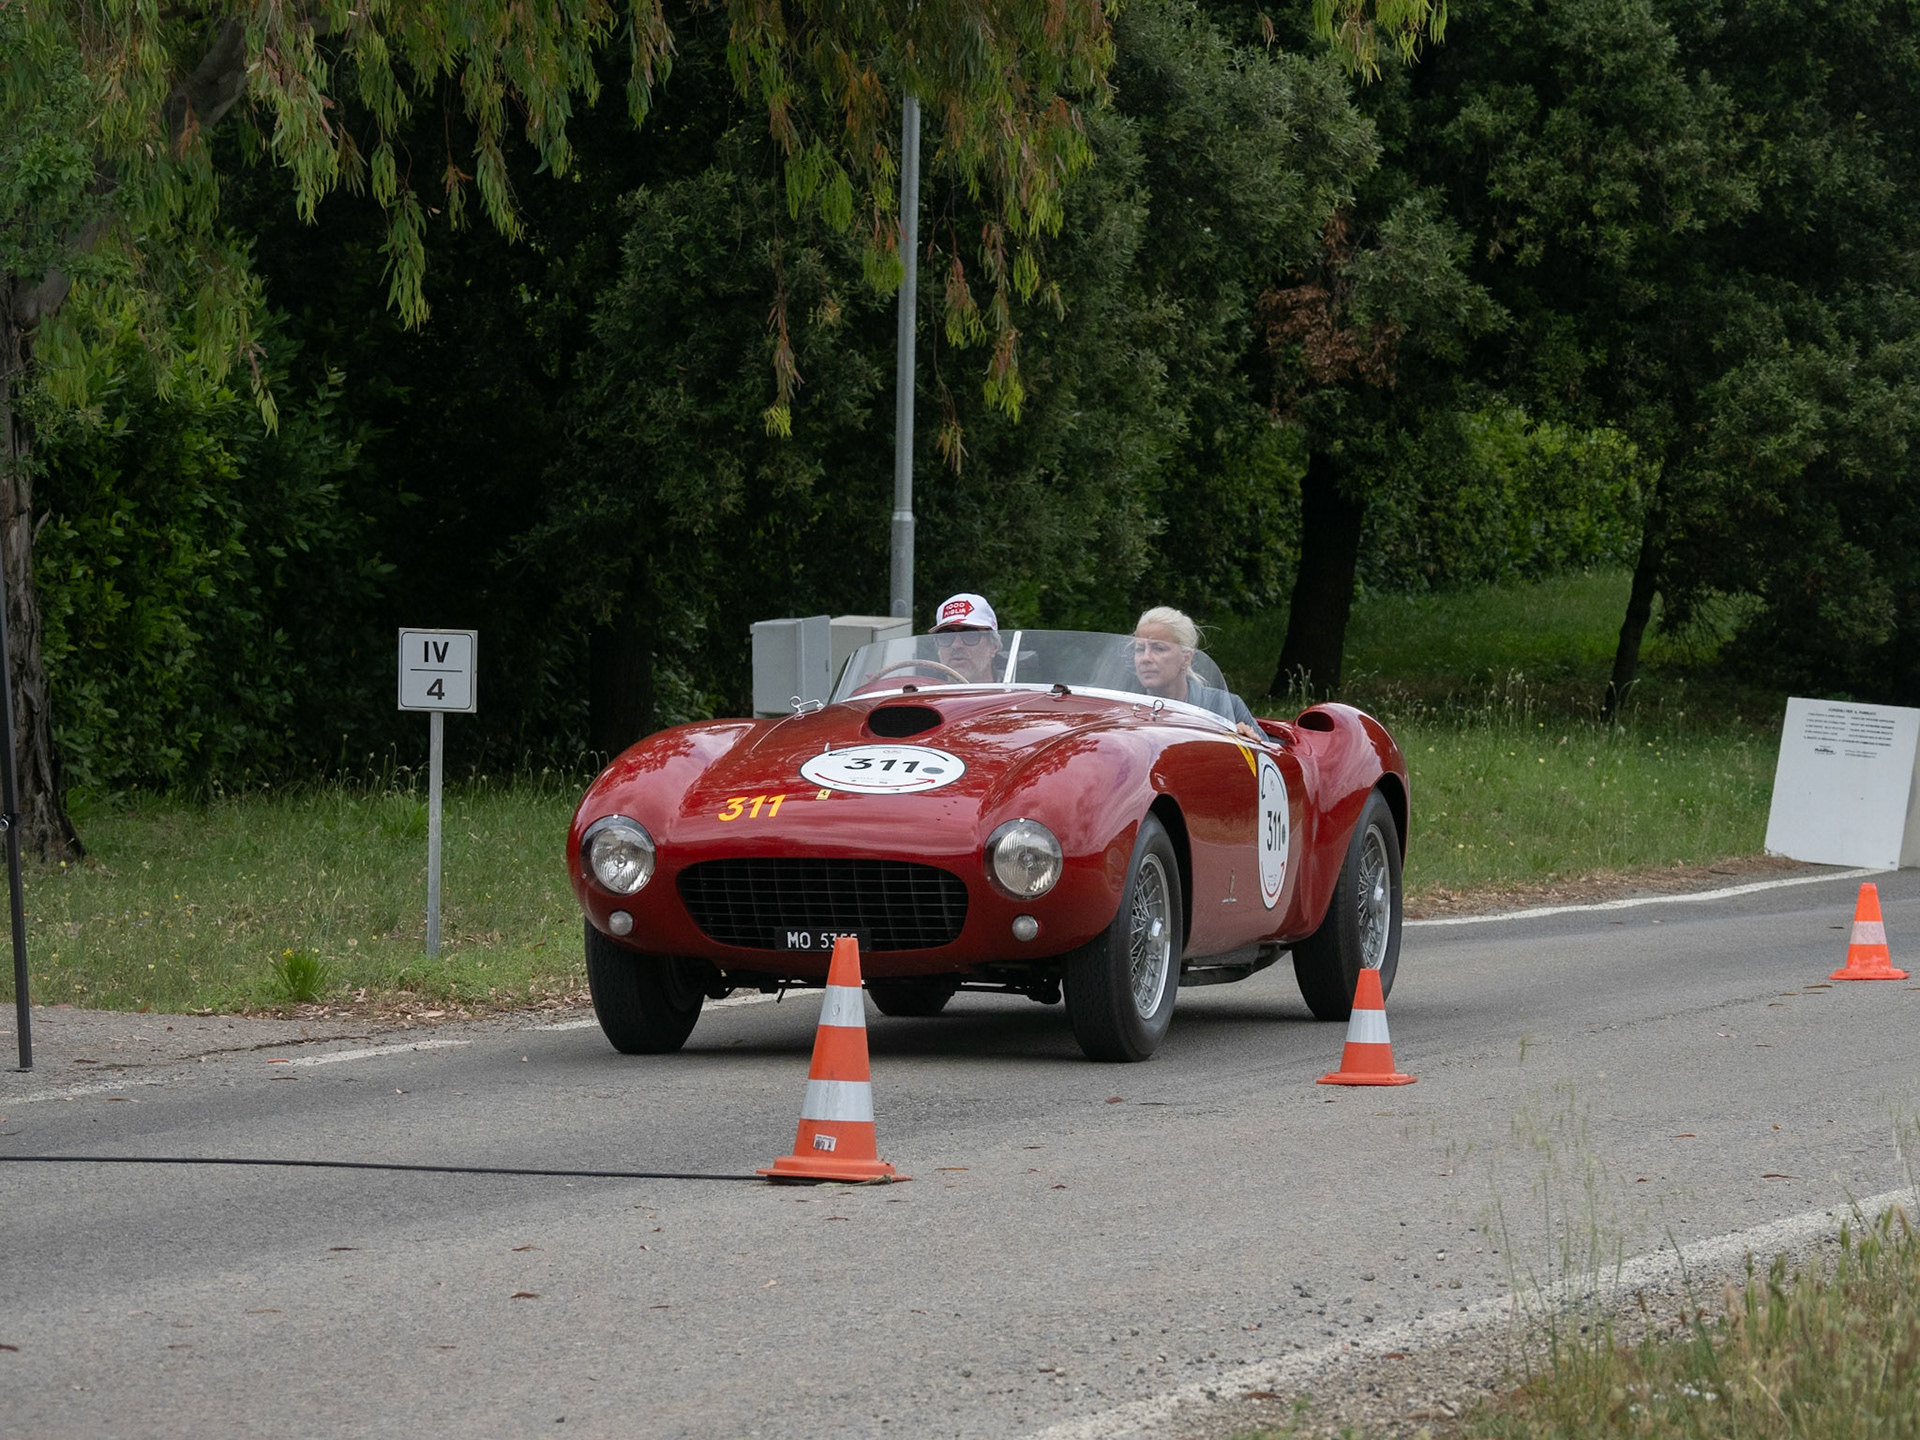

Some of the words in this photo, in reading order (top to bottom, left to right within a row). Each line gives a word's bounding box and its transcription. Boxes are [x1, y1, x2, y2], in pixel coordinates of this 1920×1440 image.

[945, 602, 965, 610] 1000
[424, 641, 449, 663] IV
[427, 678, 445, 700] 4
[843, 758, 920, 773] 311
[718, 794, 786, 821] 311
[1267, 810, 1281, 851] 311
[787, 931, 811, 949] MO
[820, 932, 858, 949] 53
